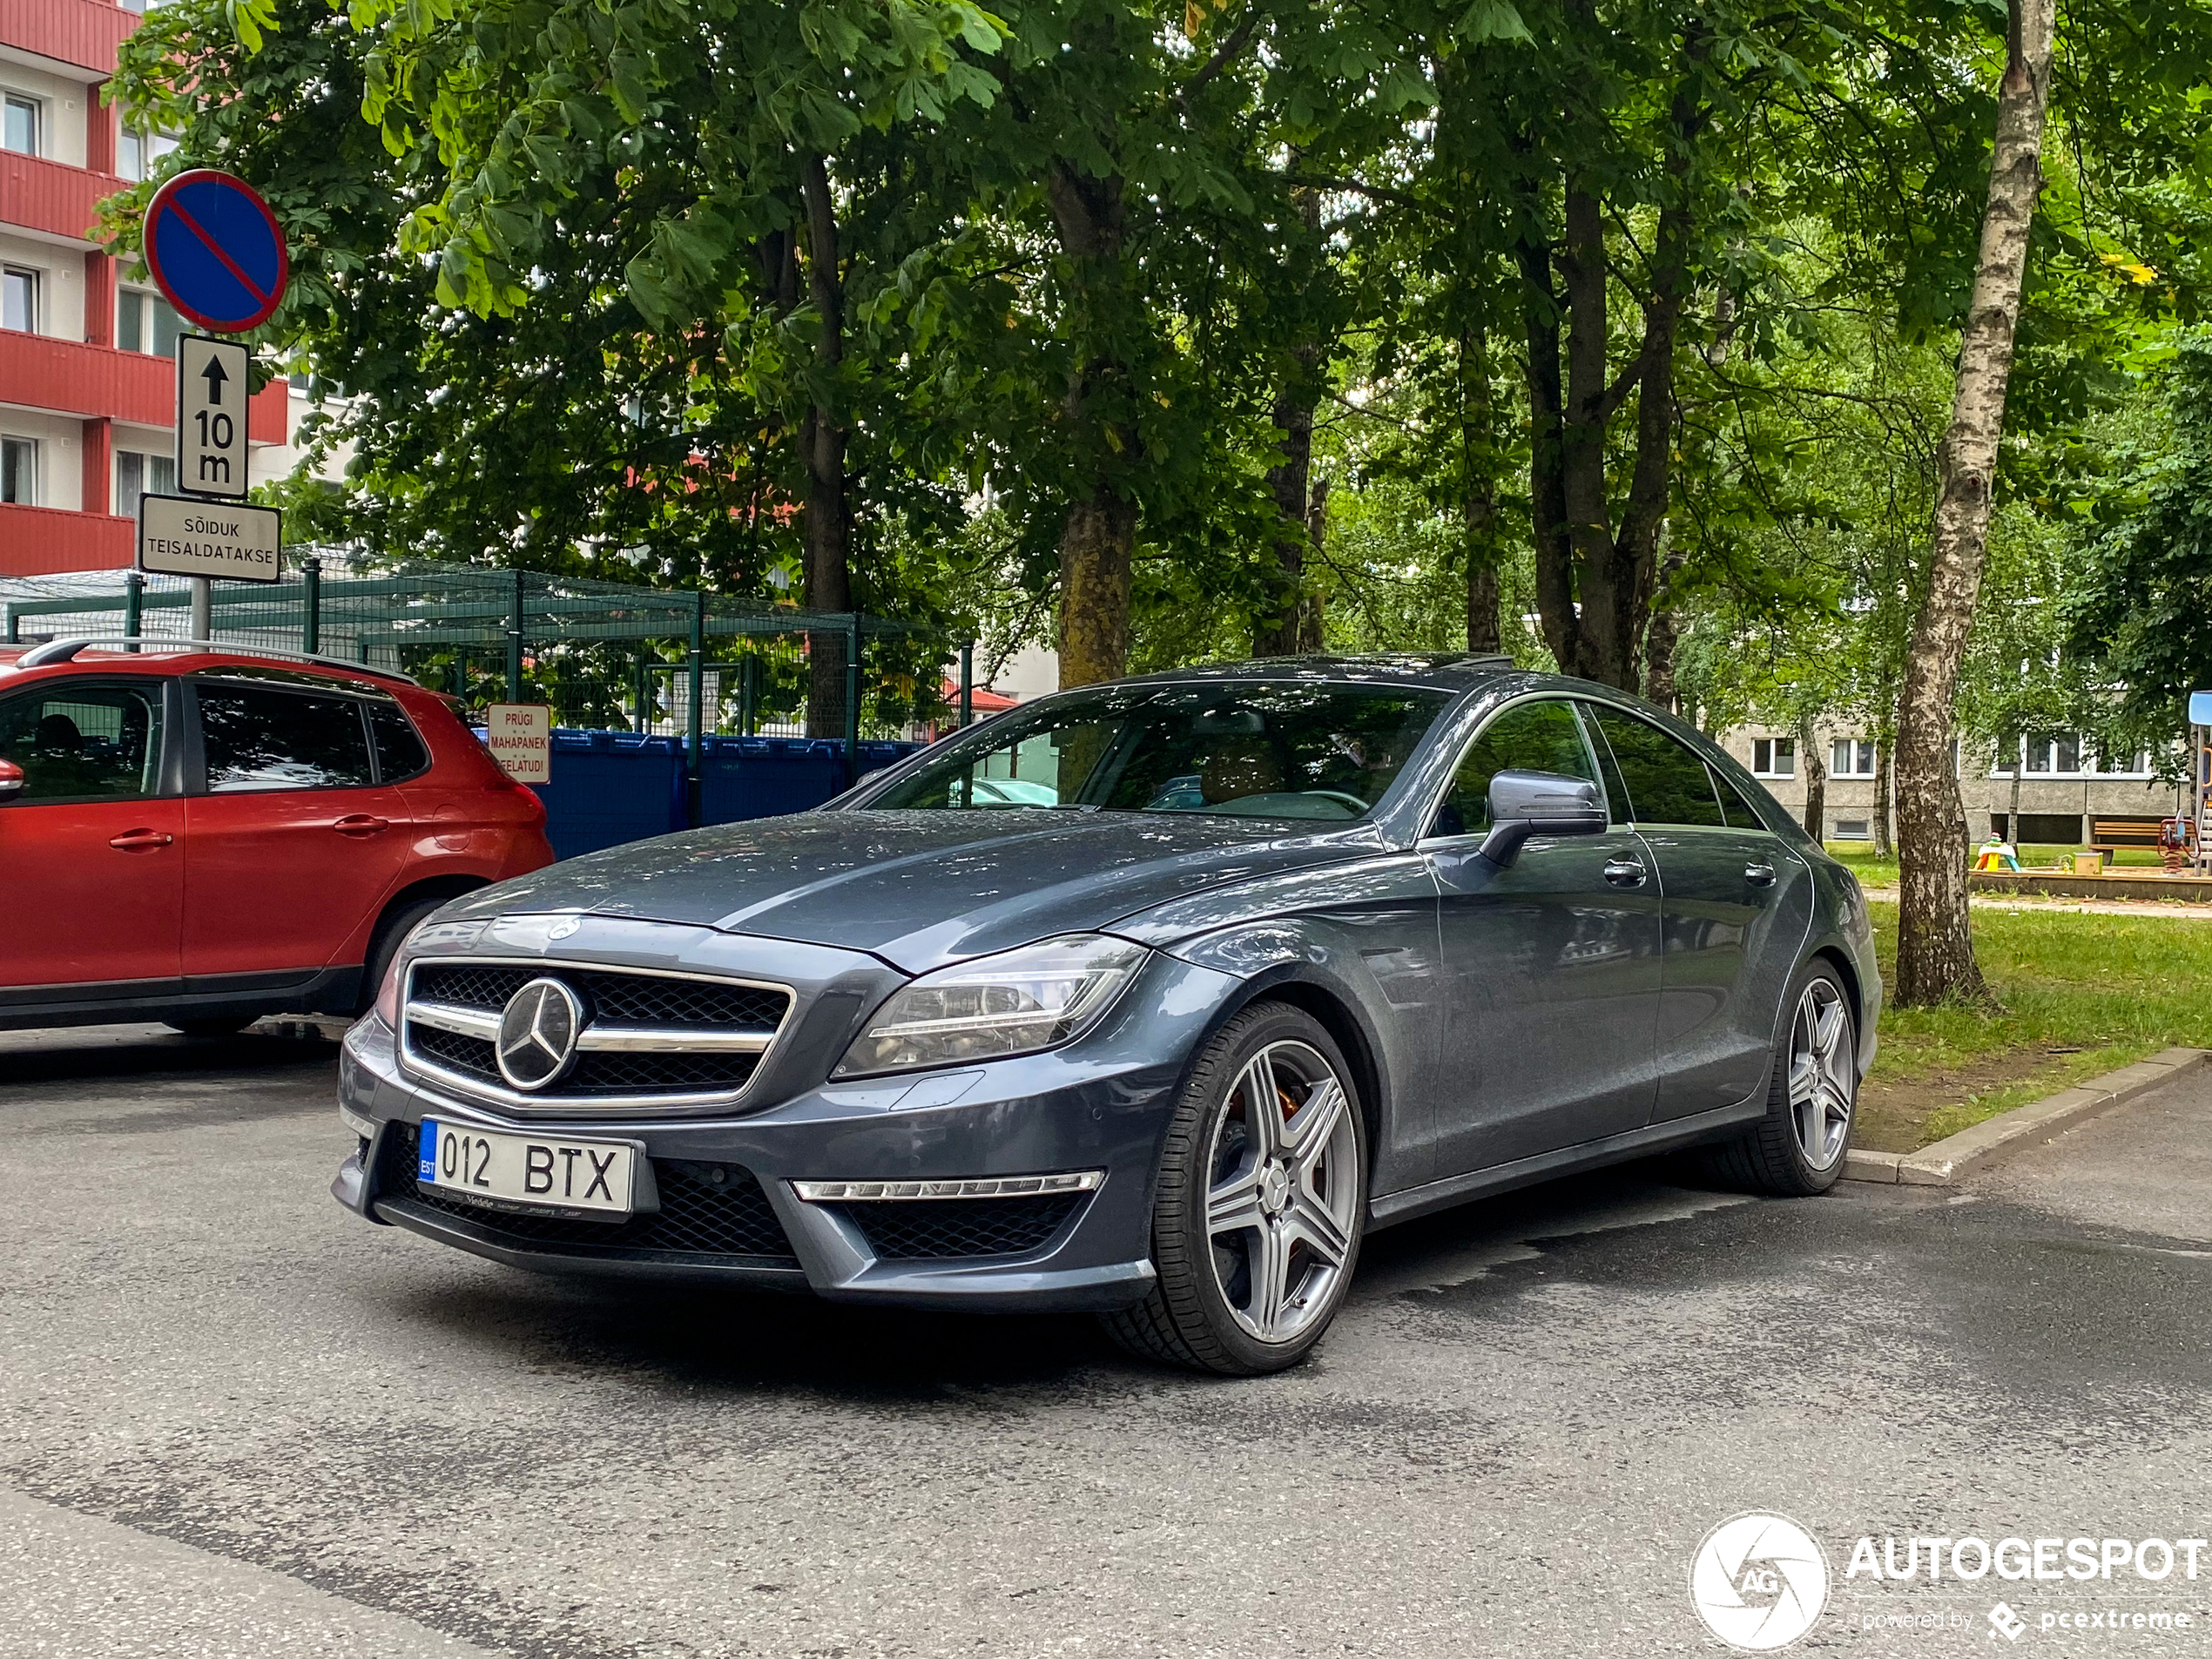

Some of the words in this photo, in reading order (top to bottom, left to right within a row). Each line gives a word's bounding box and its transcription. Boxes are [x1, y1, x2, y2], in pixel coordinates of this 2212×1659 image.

[194, 409, 233, 449] 10
[199, 454, 230, 484] m
[184, 516, 239, 537] SÕIDUK
[147, 538, 273, 564] TEISALDATAKSE
[505, 710, 533, 726] PRÜGI
[491, 736, 547, 750] MAHAPANEK
[421, 1159, 435, 1176] EST
[442, 1131, 489, 1188] 012
[524, 1143, 617, 1202] BTX
